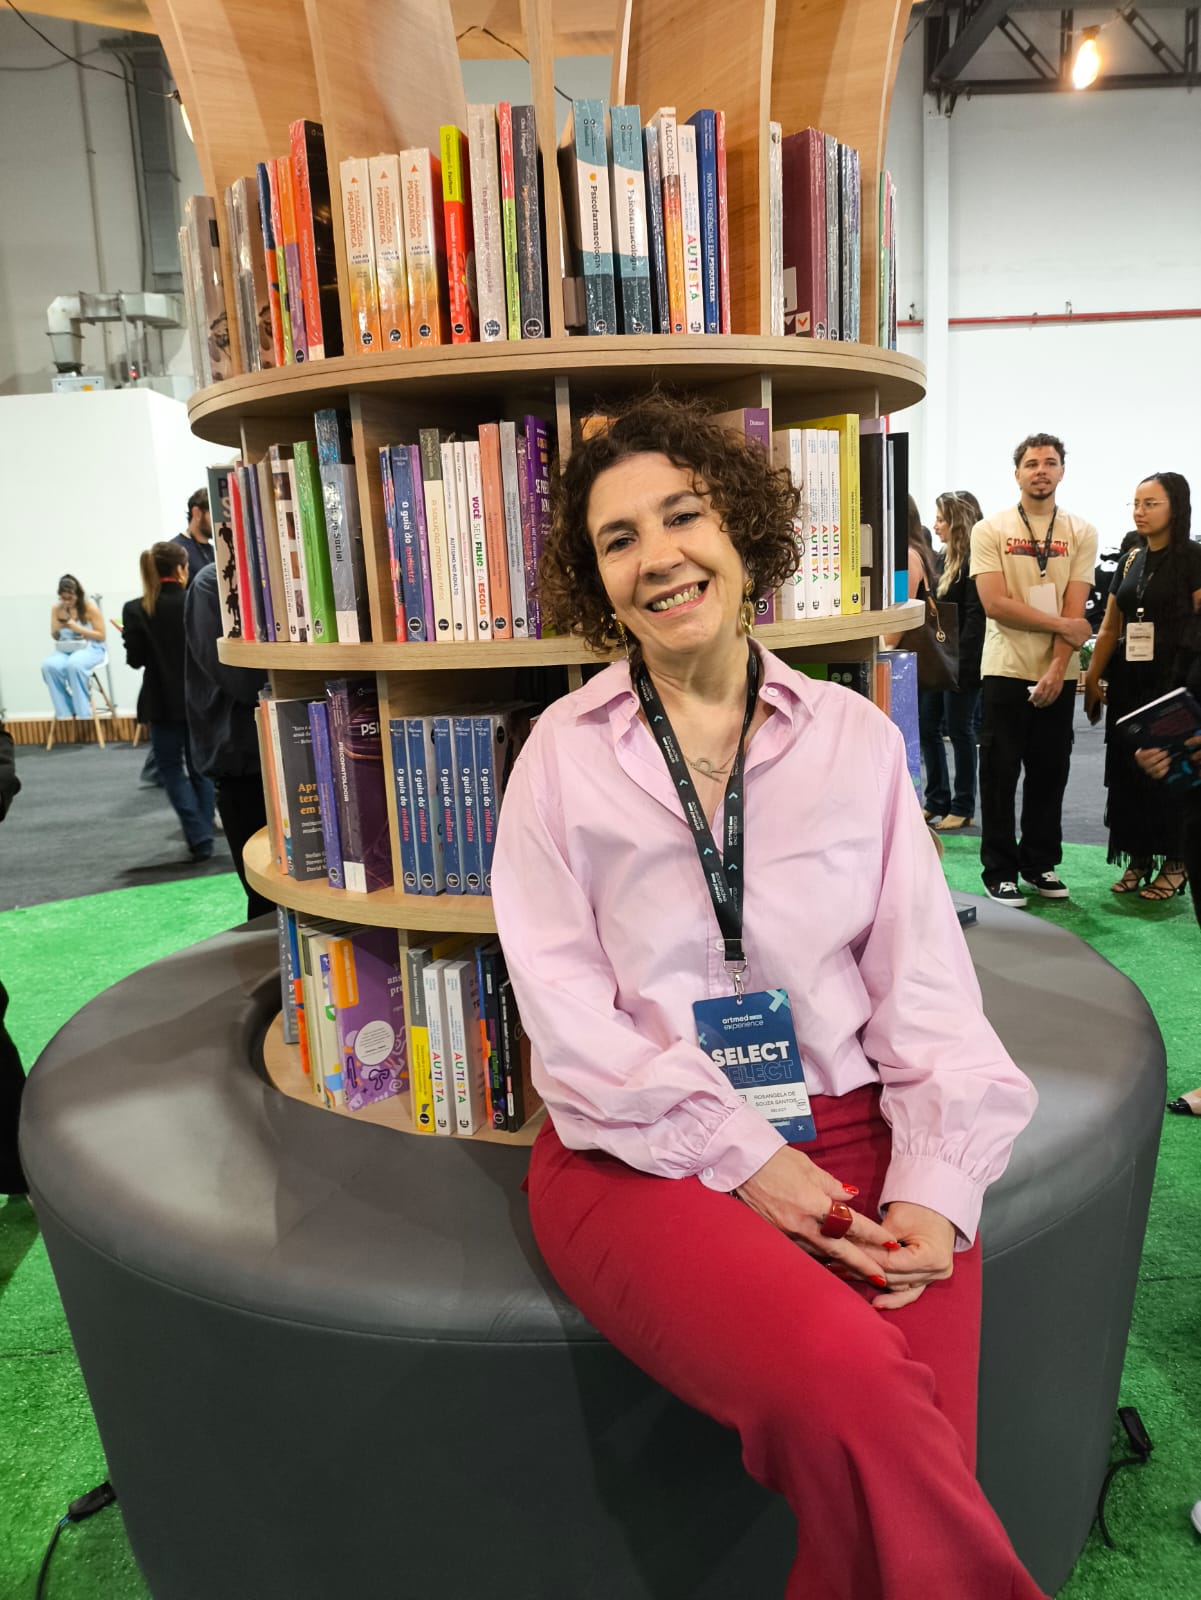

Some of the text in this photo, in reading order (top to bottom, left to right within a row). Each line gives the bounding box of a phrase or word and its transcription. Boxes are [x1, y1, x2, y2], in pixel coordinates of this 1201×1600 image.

[347, 191, 358, 248] PSIQUIÁTRICA
[354, 190, 363, 248] FARMACOLOGIA
[376, 186, 386, 245] PSIQUIÁTRICA
[384, 186, 393, 244] FARMACOLOGIA
[407, 180, 417, 239] PSIQUIÁTRICA
[706, 198, 715, 243] TENDÊNCIAS
[590, 185, 602, 269] Psicofarmacologia
[687, 234, 700, 300] AUTISTA
[401, 510, 412, 531] guia
[472, 523, 481, 540] SEU
[334, 533, 345, 562] Social
[404, 532, 414, 544] do
[450, 537, 458, 565] AUTISMO
[475, 541, 484, 567] FILHO
[810, 525, 819, 582] AUTISTA
[822, 524, 830, 580] AUTISTA
[478, 582, 487, 616] ESCOLA
[664, 745, 676, 764] artmed
[338, 741, 349, 803] PSICOPATOLOGIA
[397, 776, 407, 794] guia
[462, 776, 471, 794] guia
[480, 776, 490, 794] guia
[415, 777, 424, 795] guia
[440, 776, 450, 795] guia
[300, 806, 316, 815] em
[400, 796, 408, 807] do
[418, 796, 426, 807] do
[443, 796, 452, 807] do
[465, 796, 473, 806] do
[484, 796, 492, 807] do
[401, 807, 410, 842] midiatra
[418, 808, 428, 843] midiatra
[444, 808, 454, 843] midiatra
[465, 808, 474, 842] midiatra
[484, 808, 493, 843] midiatra
[690, 811, 701, 831] artmed
[711, 883, 723, 904] artmed
[721, 1014, 749, 1025] artmed
[723, 1019, 764, 1031] experience
[711, 1040, 790, 1067] SELECT
[432, 1052, 445, 1104] AUTISTA
[454, 1052, 466, 1104] AUTISTA
[724, 1059, 794, 1085] ELECT
[753, 1092, 786, 1100] ROSANGELA
[755, 1098, 797, 1107] SOUZA SANTOS
